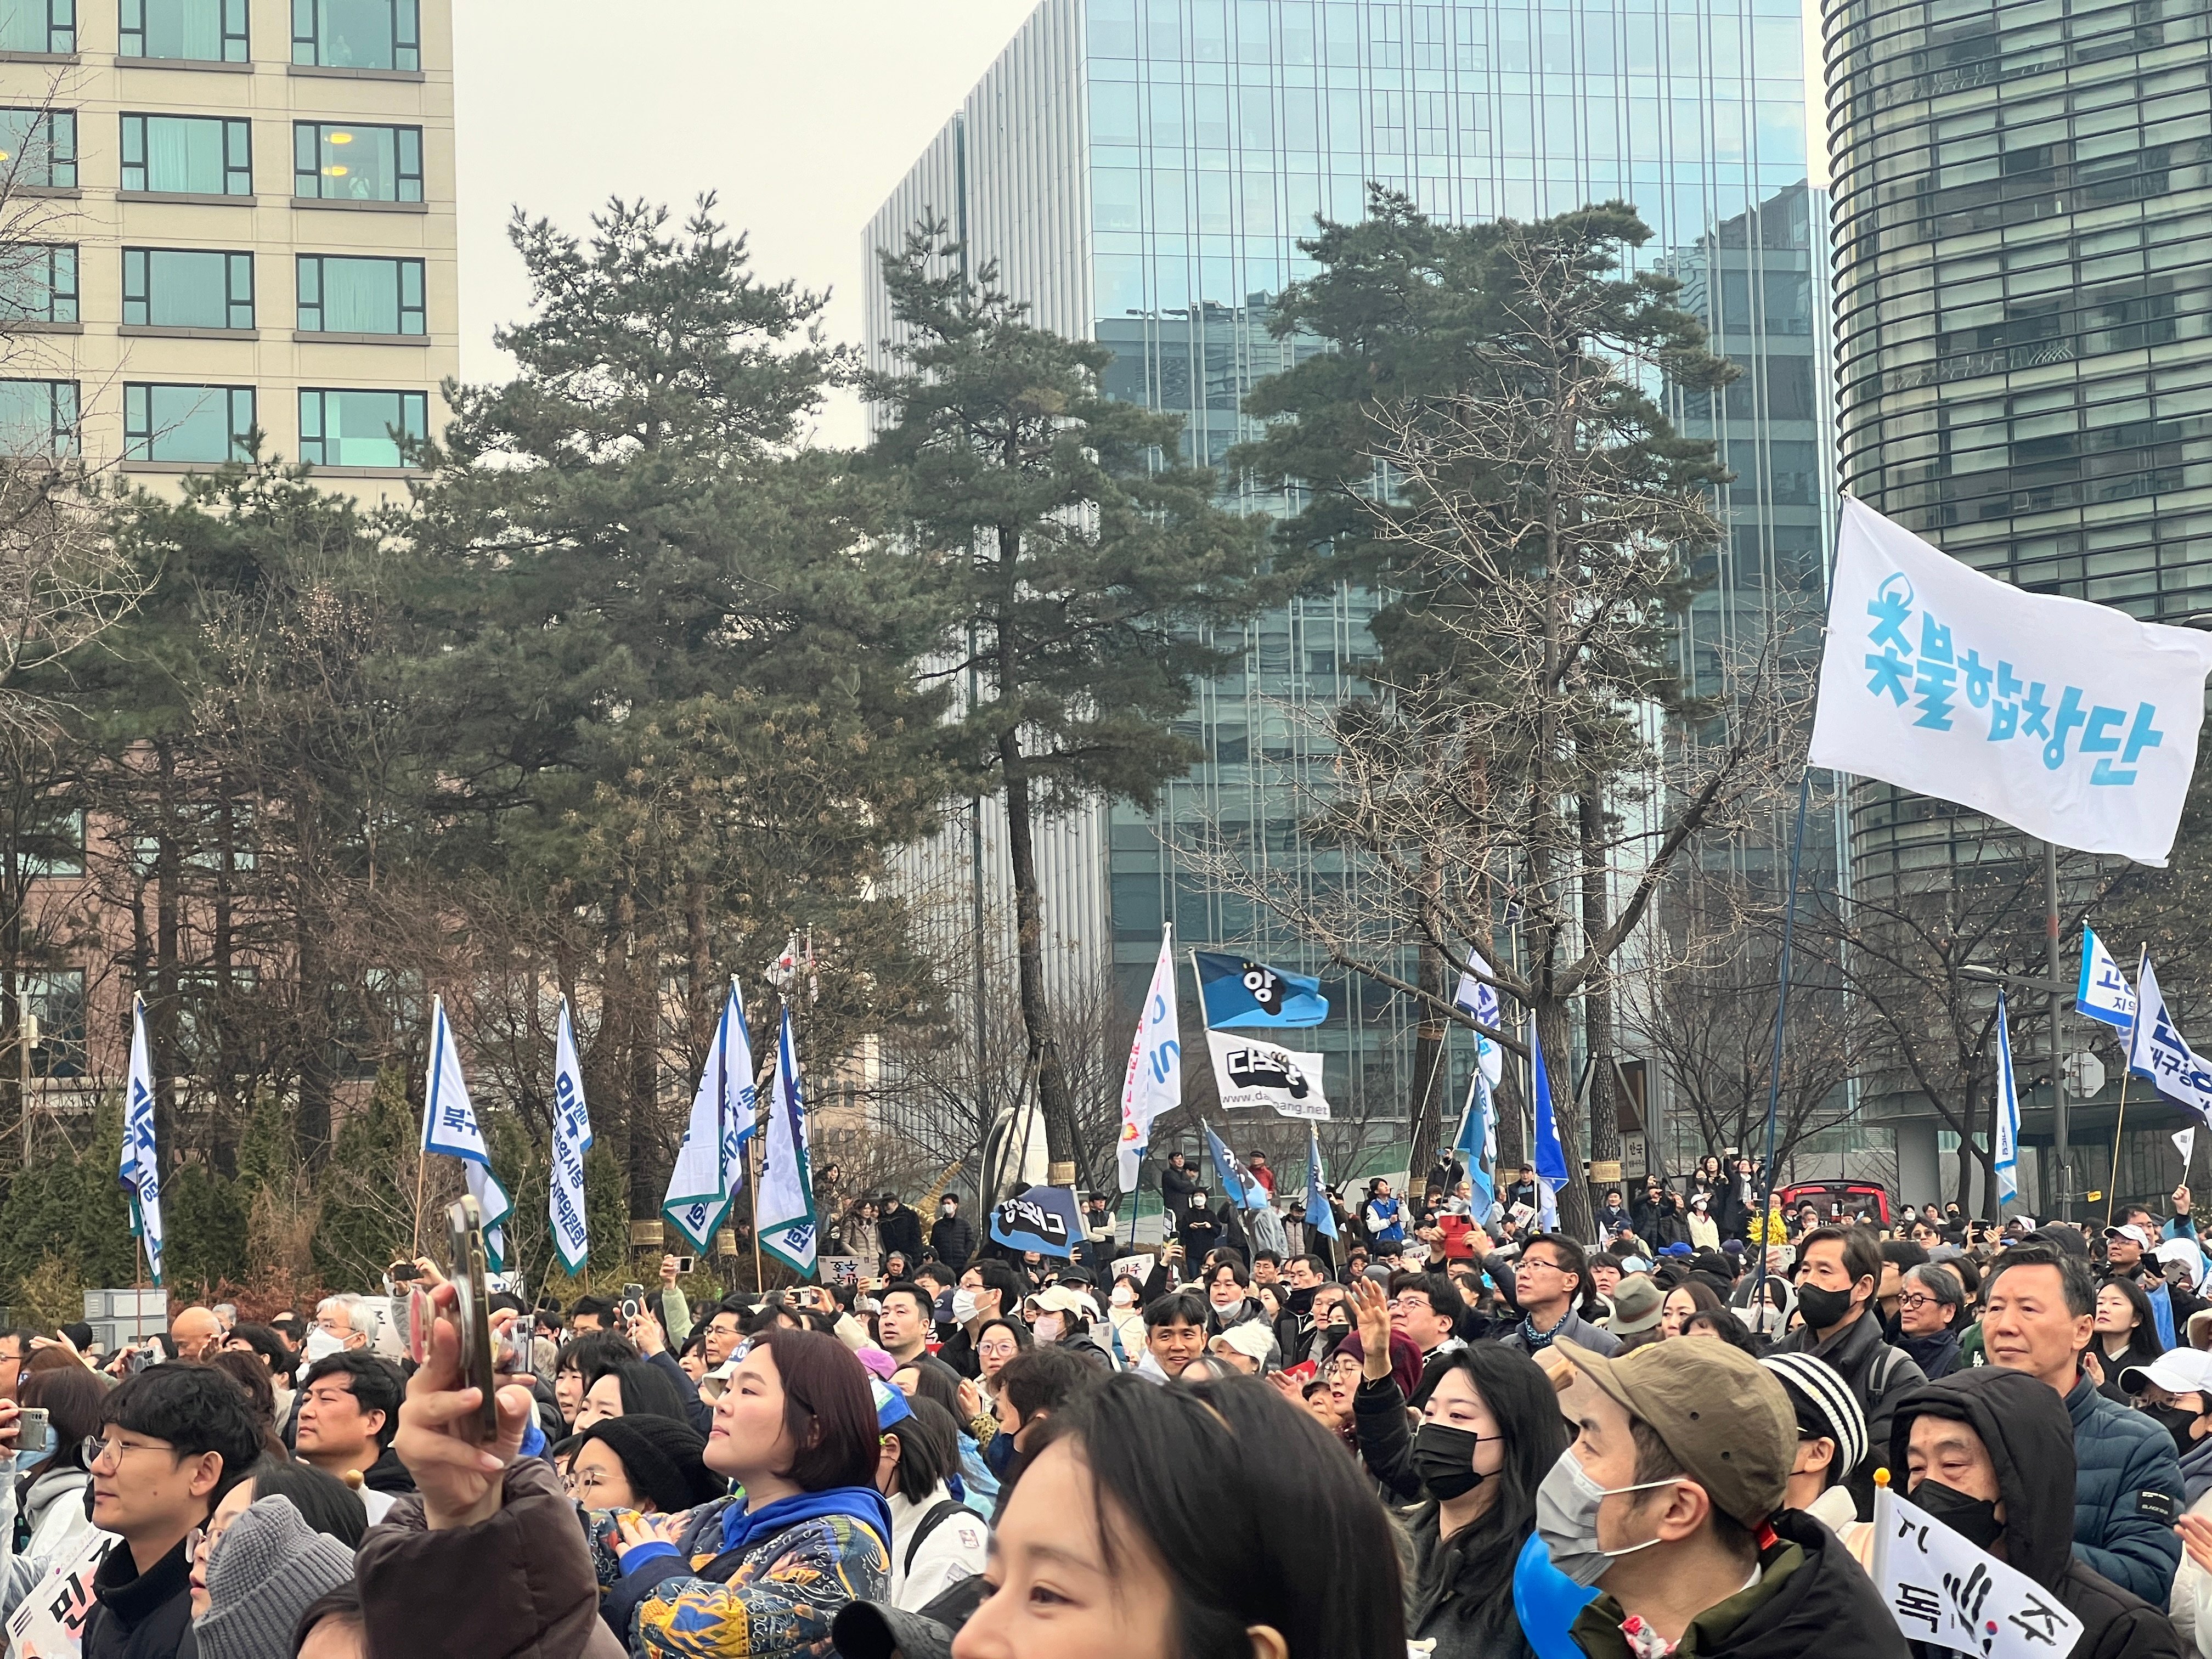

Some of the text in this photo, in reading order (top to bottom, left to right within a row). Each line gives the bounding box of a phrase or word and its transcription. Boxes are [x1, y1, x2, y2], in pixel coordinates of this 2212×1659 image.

[1865, 572, 2164, 786] 촛불합창단
[1629, 1142, 1643, 1158] 안국
[1972, 1351, 1984, 1368] LA
